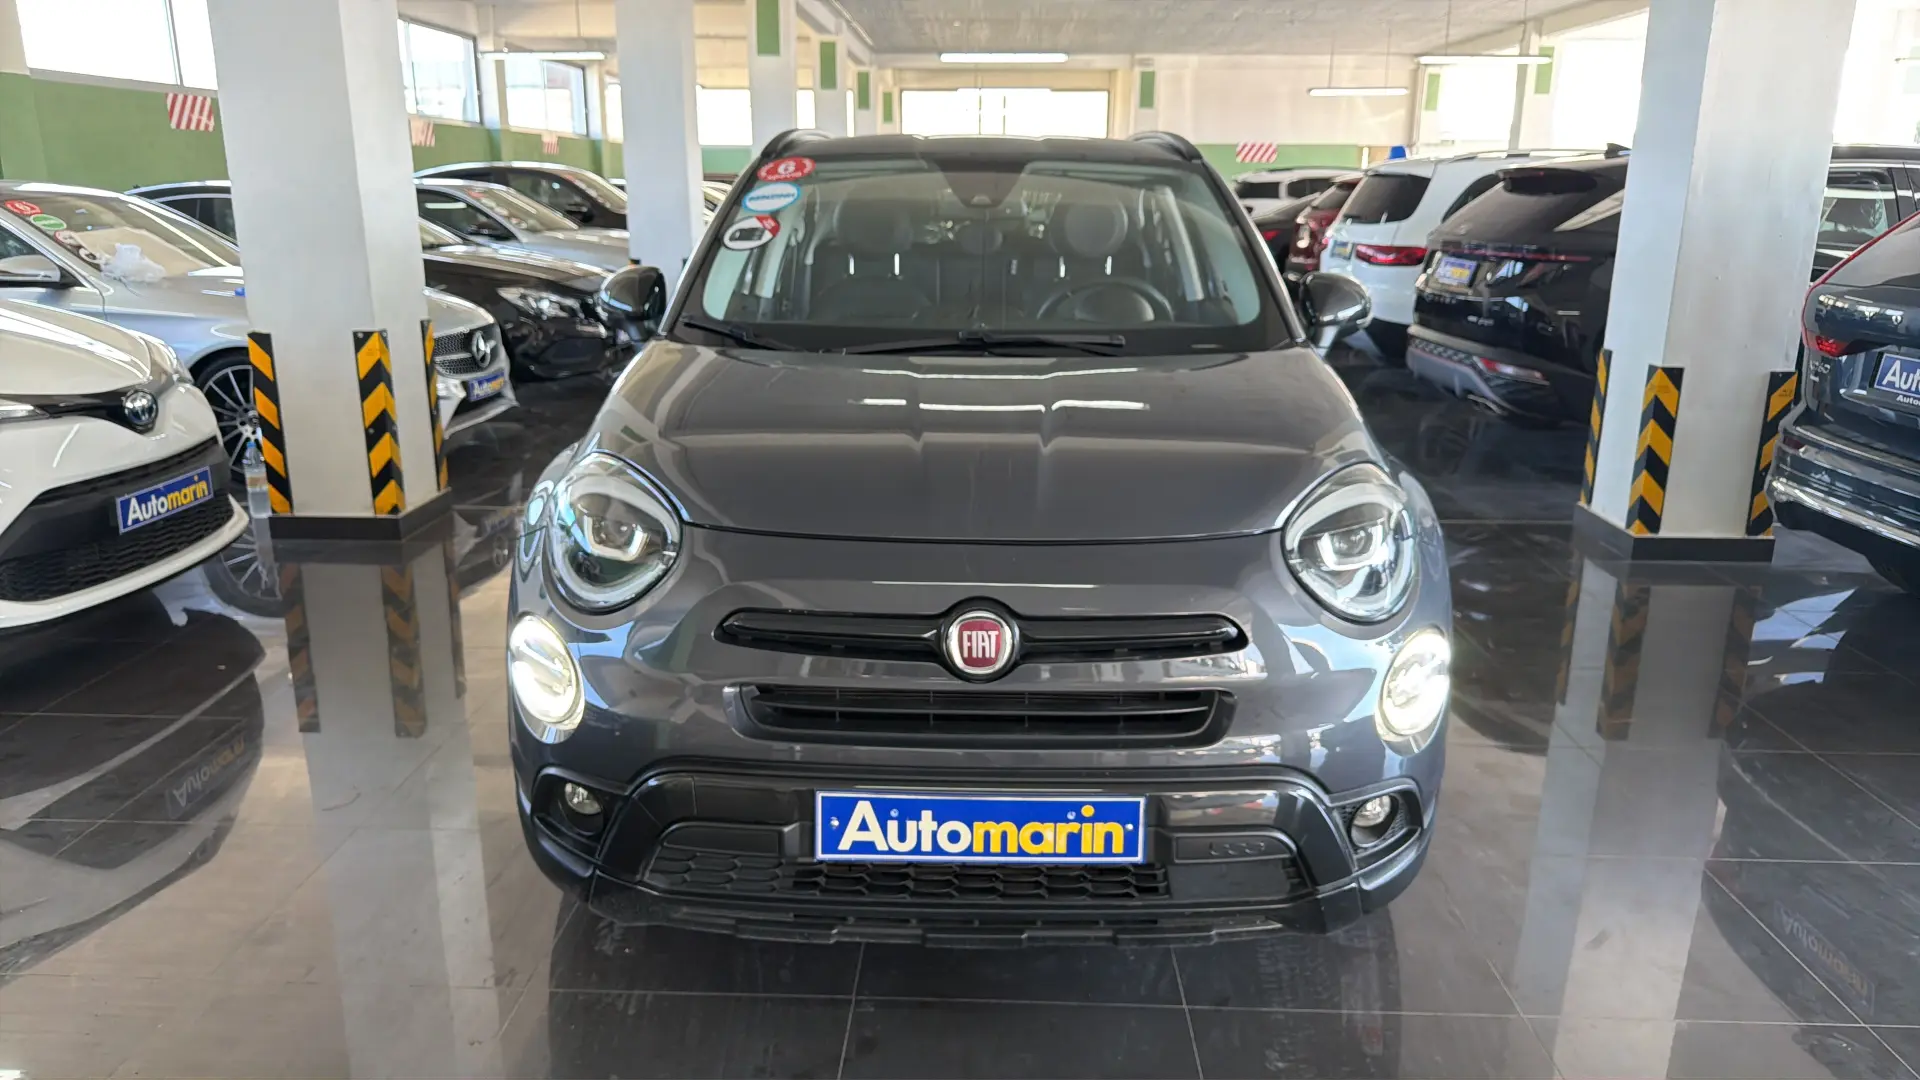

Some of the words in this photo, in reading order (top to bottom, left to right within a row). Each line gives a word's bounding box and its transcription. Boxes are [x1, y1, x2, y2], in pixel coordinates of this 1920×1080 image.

[1896, 394, 1920, 406] Auto
[127, 475, 208, 526] Automarin
[962, 630, 999, 659] FIAT
[837, 800, 1125, 854] Automarin
